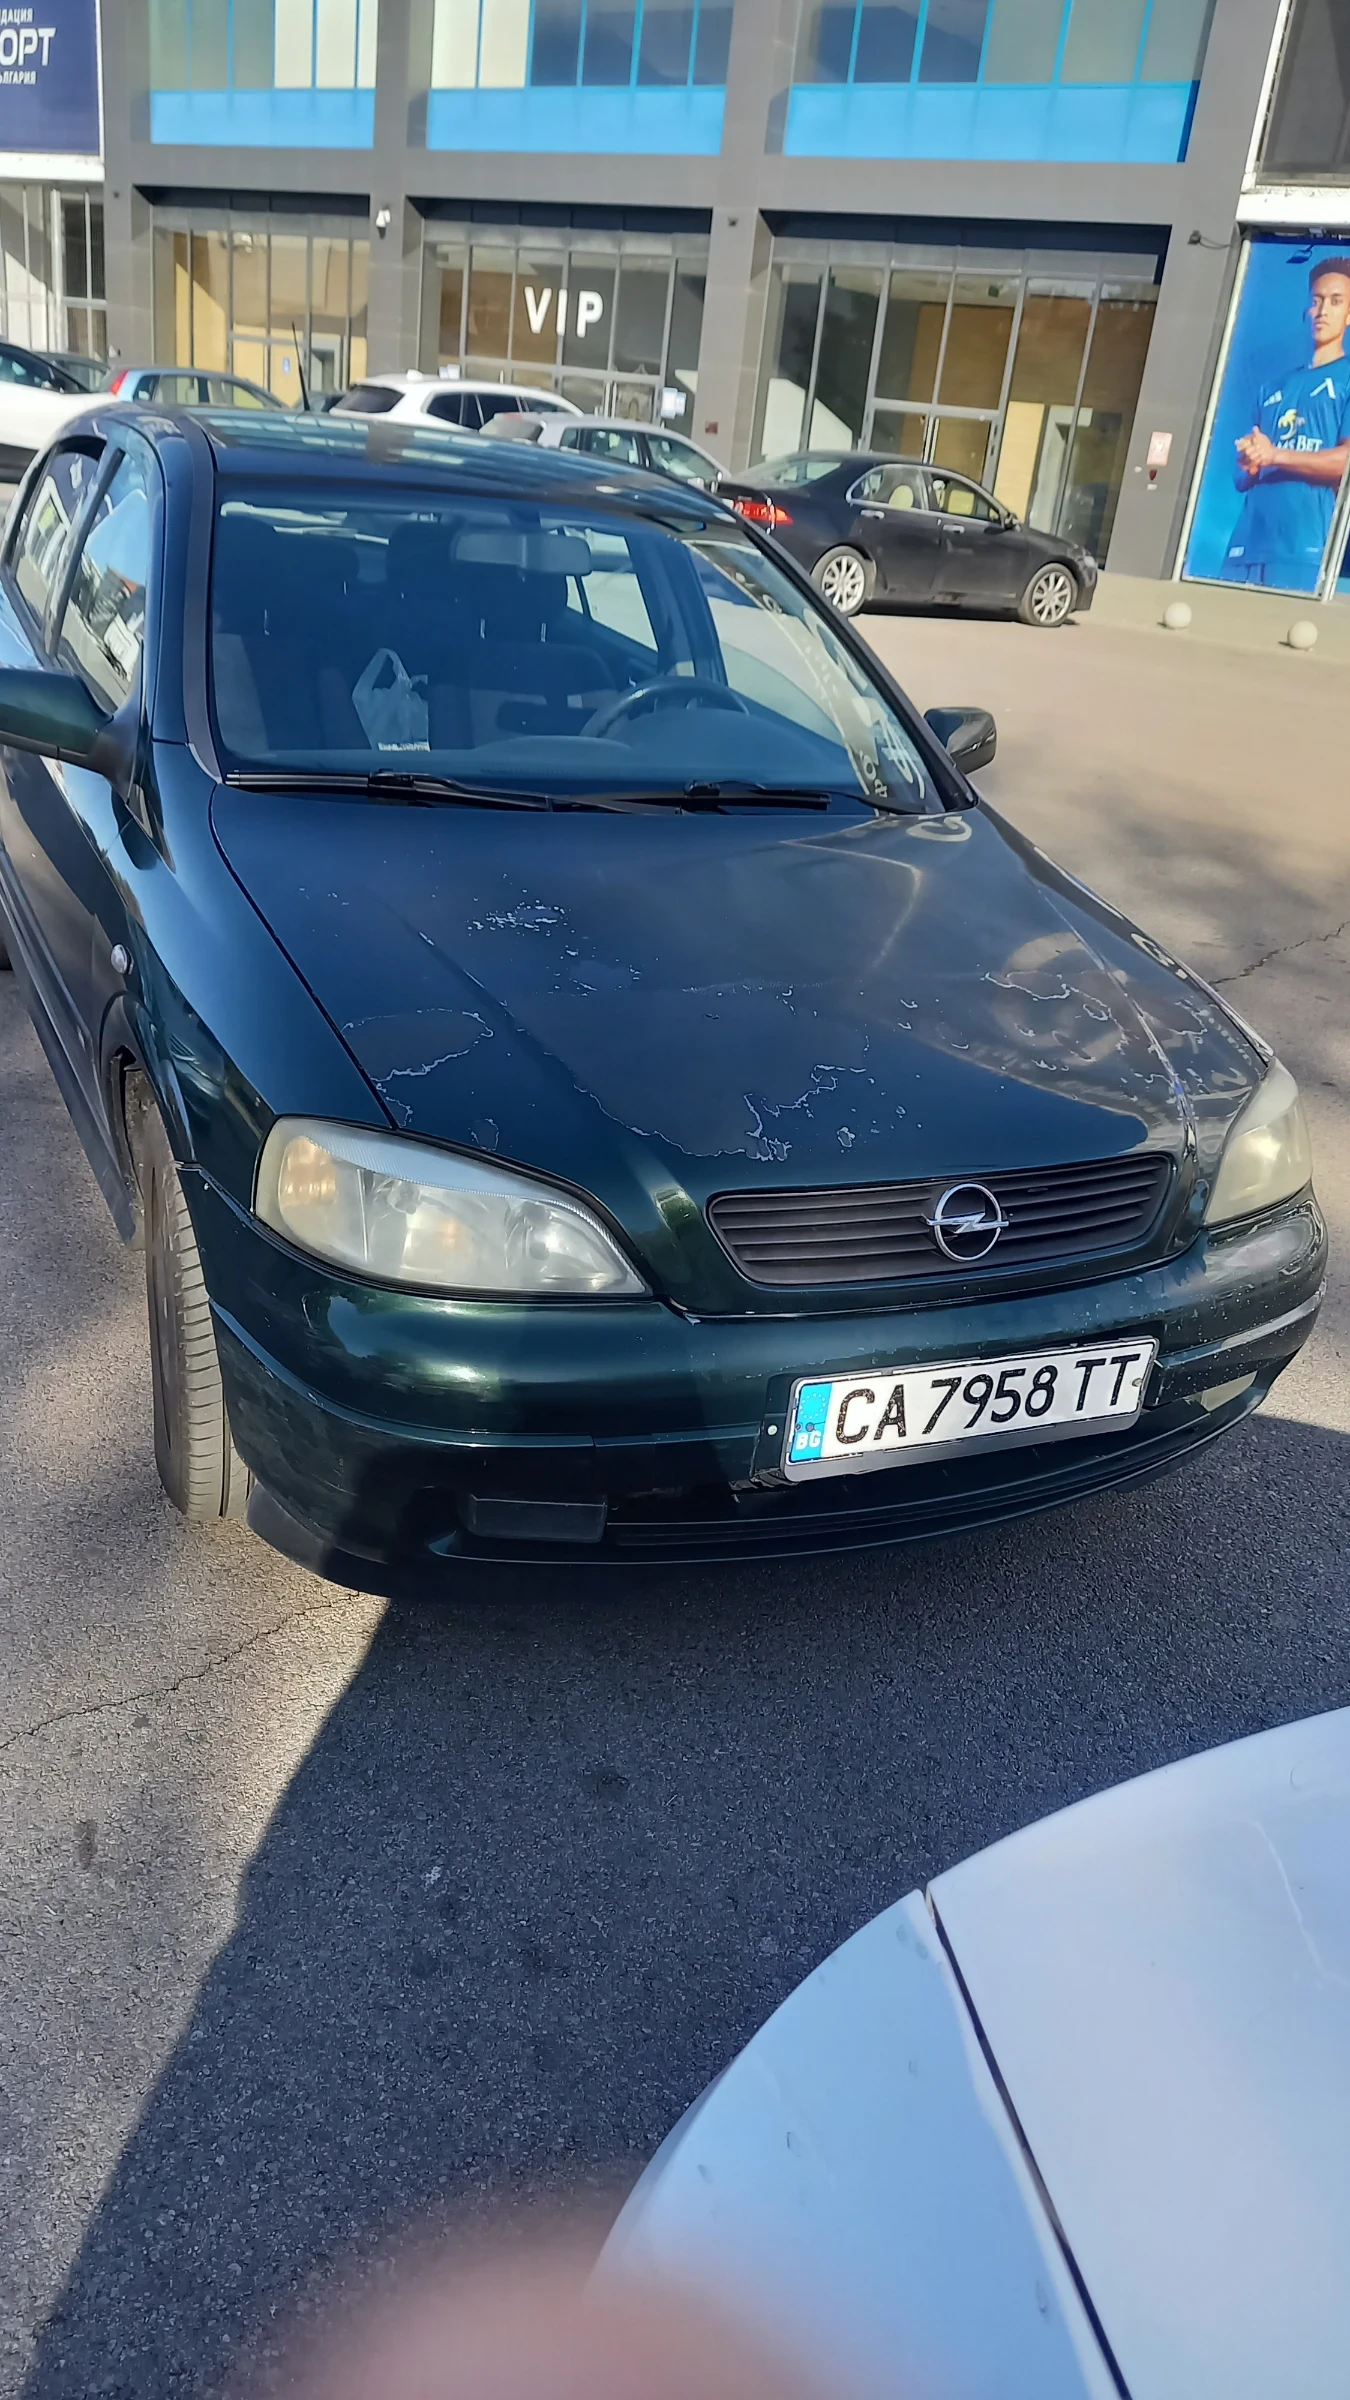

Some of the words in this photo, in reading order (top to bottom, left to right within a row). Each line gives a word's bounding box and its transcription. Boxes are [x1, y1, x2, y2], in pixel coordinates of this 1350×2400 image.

[0, 8, 33, 26] ДАЦИЯ
[524, 286, 603, 338] VIP
[835, 1383, 906, 1444] CA
[922, 1365, 1058, 1434] 7958
[1074, 1353, 1141, 1411] TT
[796, 1430, 822, 1450] BG
